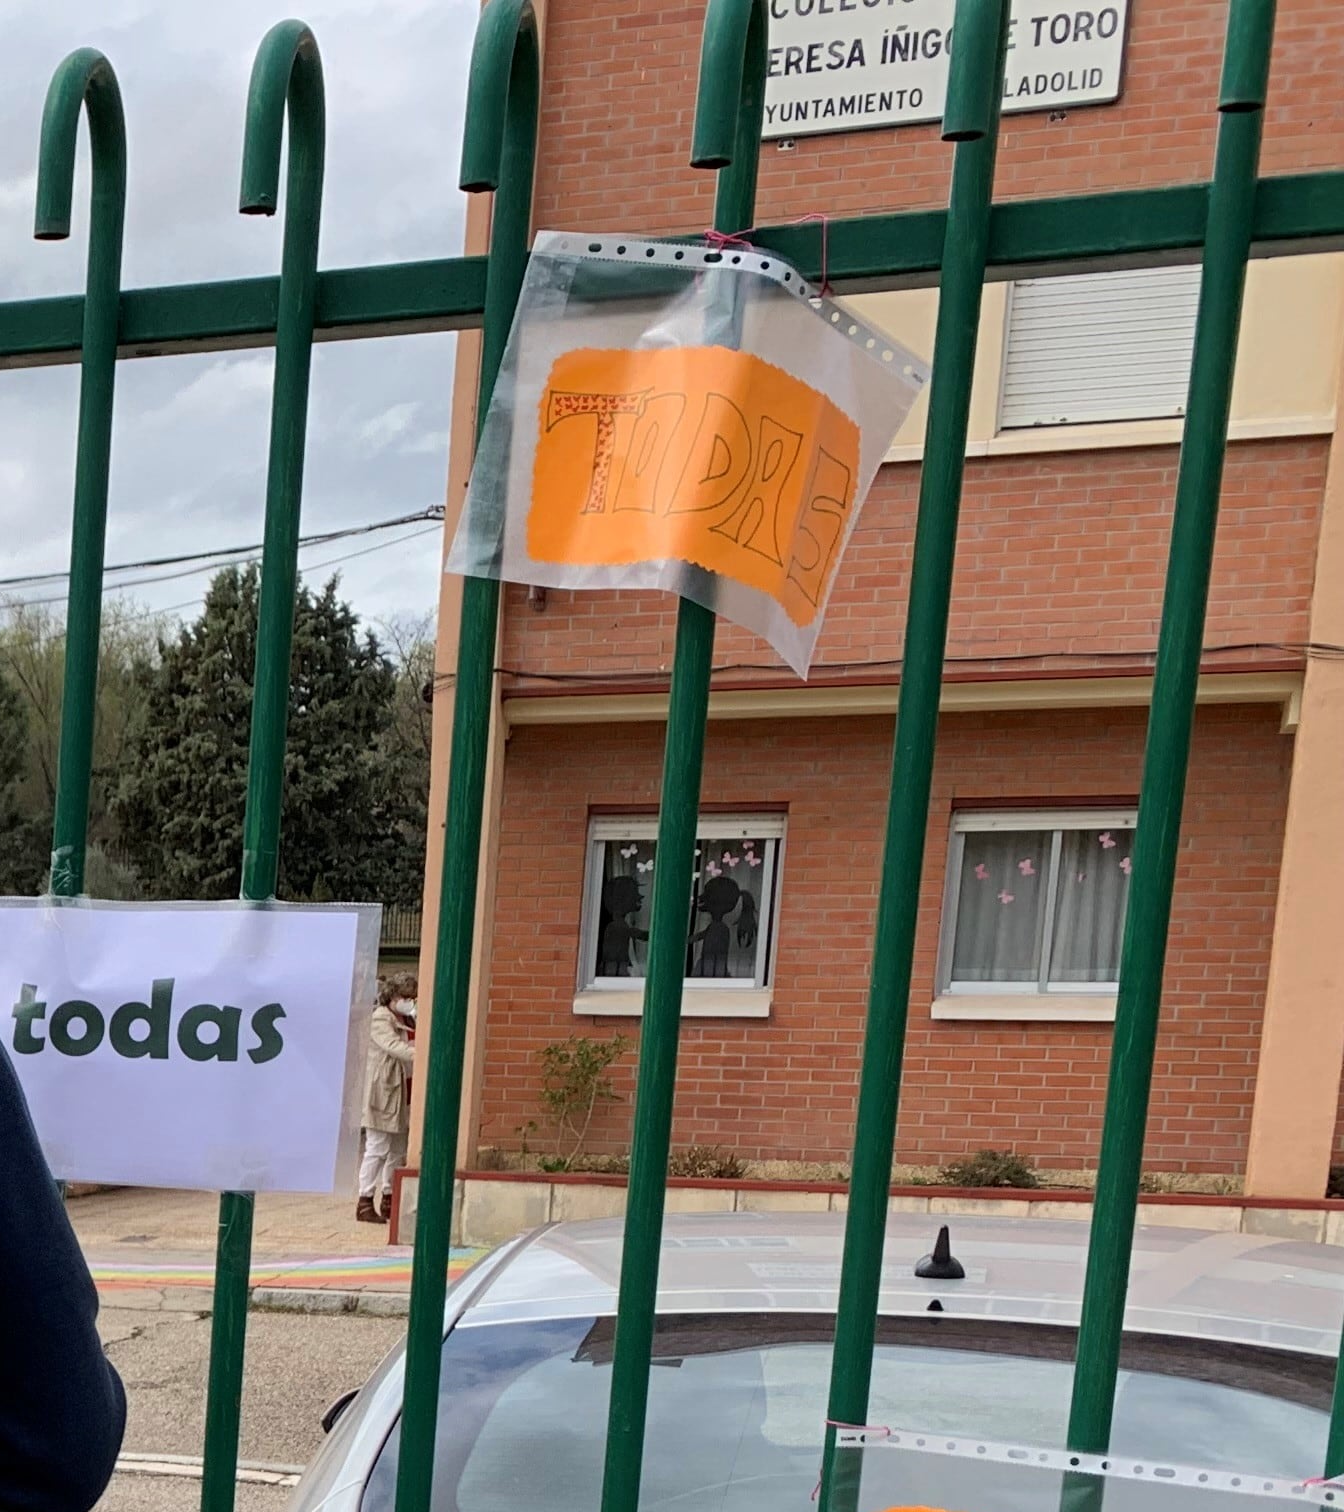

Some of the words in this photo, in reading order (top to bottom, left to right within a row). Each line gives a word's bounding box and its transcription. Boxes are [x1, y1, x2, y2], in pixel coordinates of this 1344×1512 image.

[766, 38, 866, 78] ERESA
[1030, 7, 1119, 48] TORO
[765, 87, 924, 124] YUNTAMIENTO
[1003, 67, 1103, 98] LADOLID
[546, 386, 852, 608] TODAS
[11, 978, 287, 1064] todas
